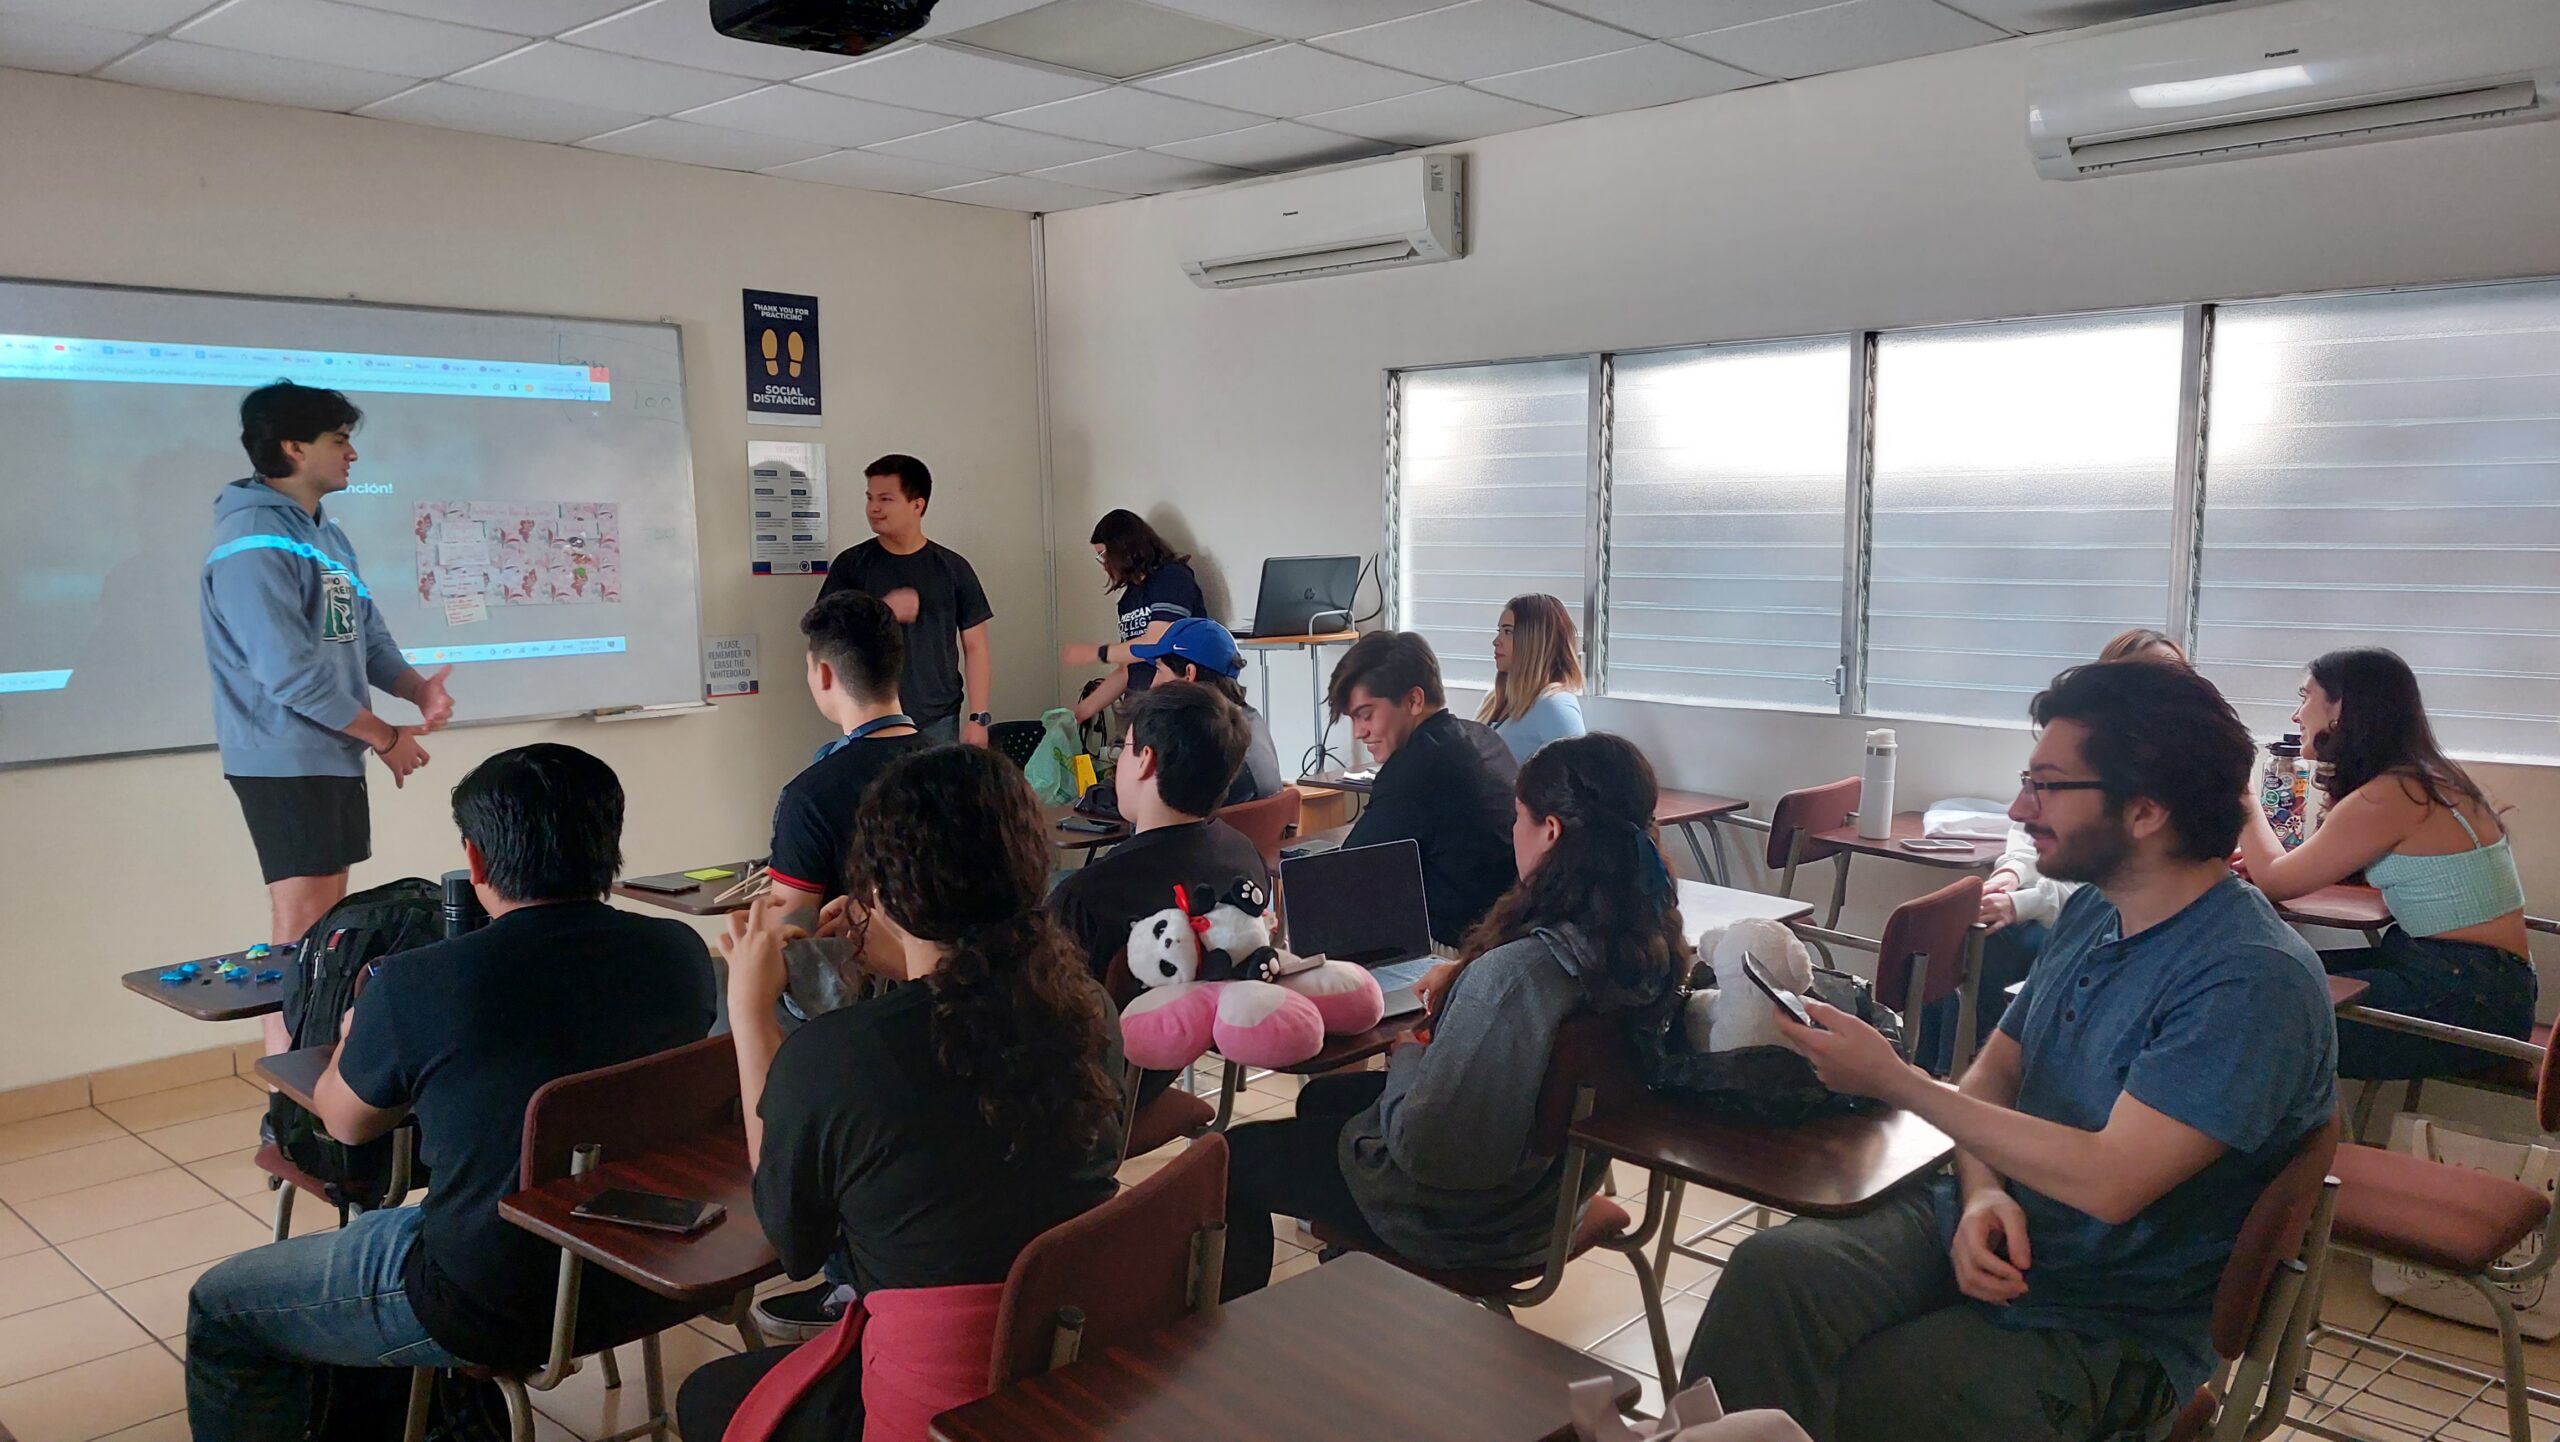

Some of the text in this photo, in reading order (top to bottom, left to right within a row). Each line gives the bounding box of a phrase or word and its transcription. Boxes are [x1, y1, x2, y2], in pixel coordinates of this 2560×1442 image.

[753, 303, 809, 316] THANK YOU FOR
[761, 311, 803, 321] PRACTICING
[765, 385, 804, 396] SOCIAL
[753, 393, 816, 406] DISTANCING
[338, 482, 393, 494] nción!
[708, 649, 751, 660] REMEMBER TO
[714, 659, 745, 669] ERASE THE
[710, 669, 751, 678] WHITEBOARD
